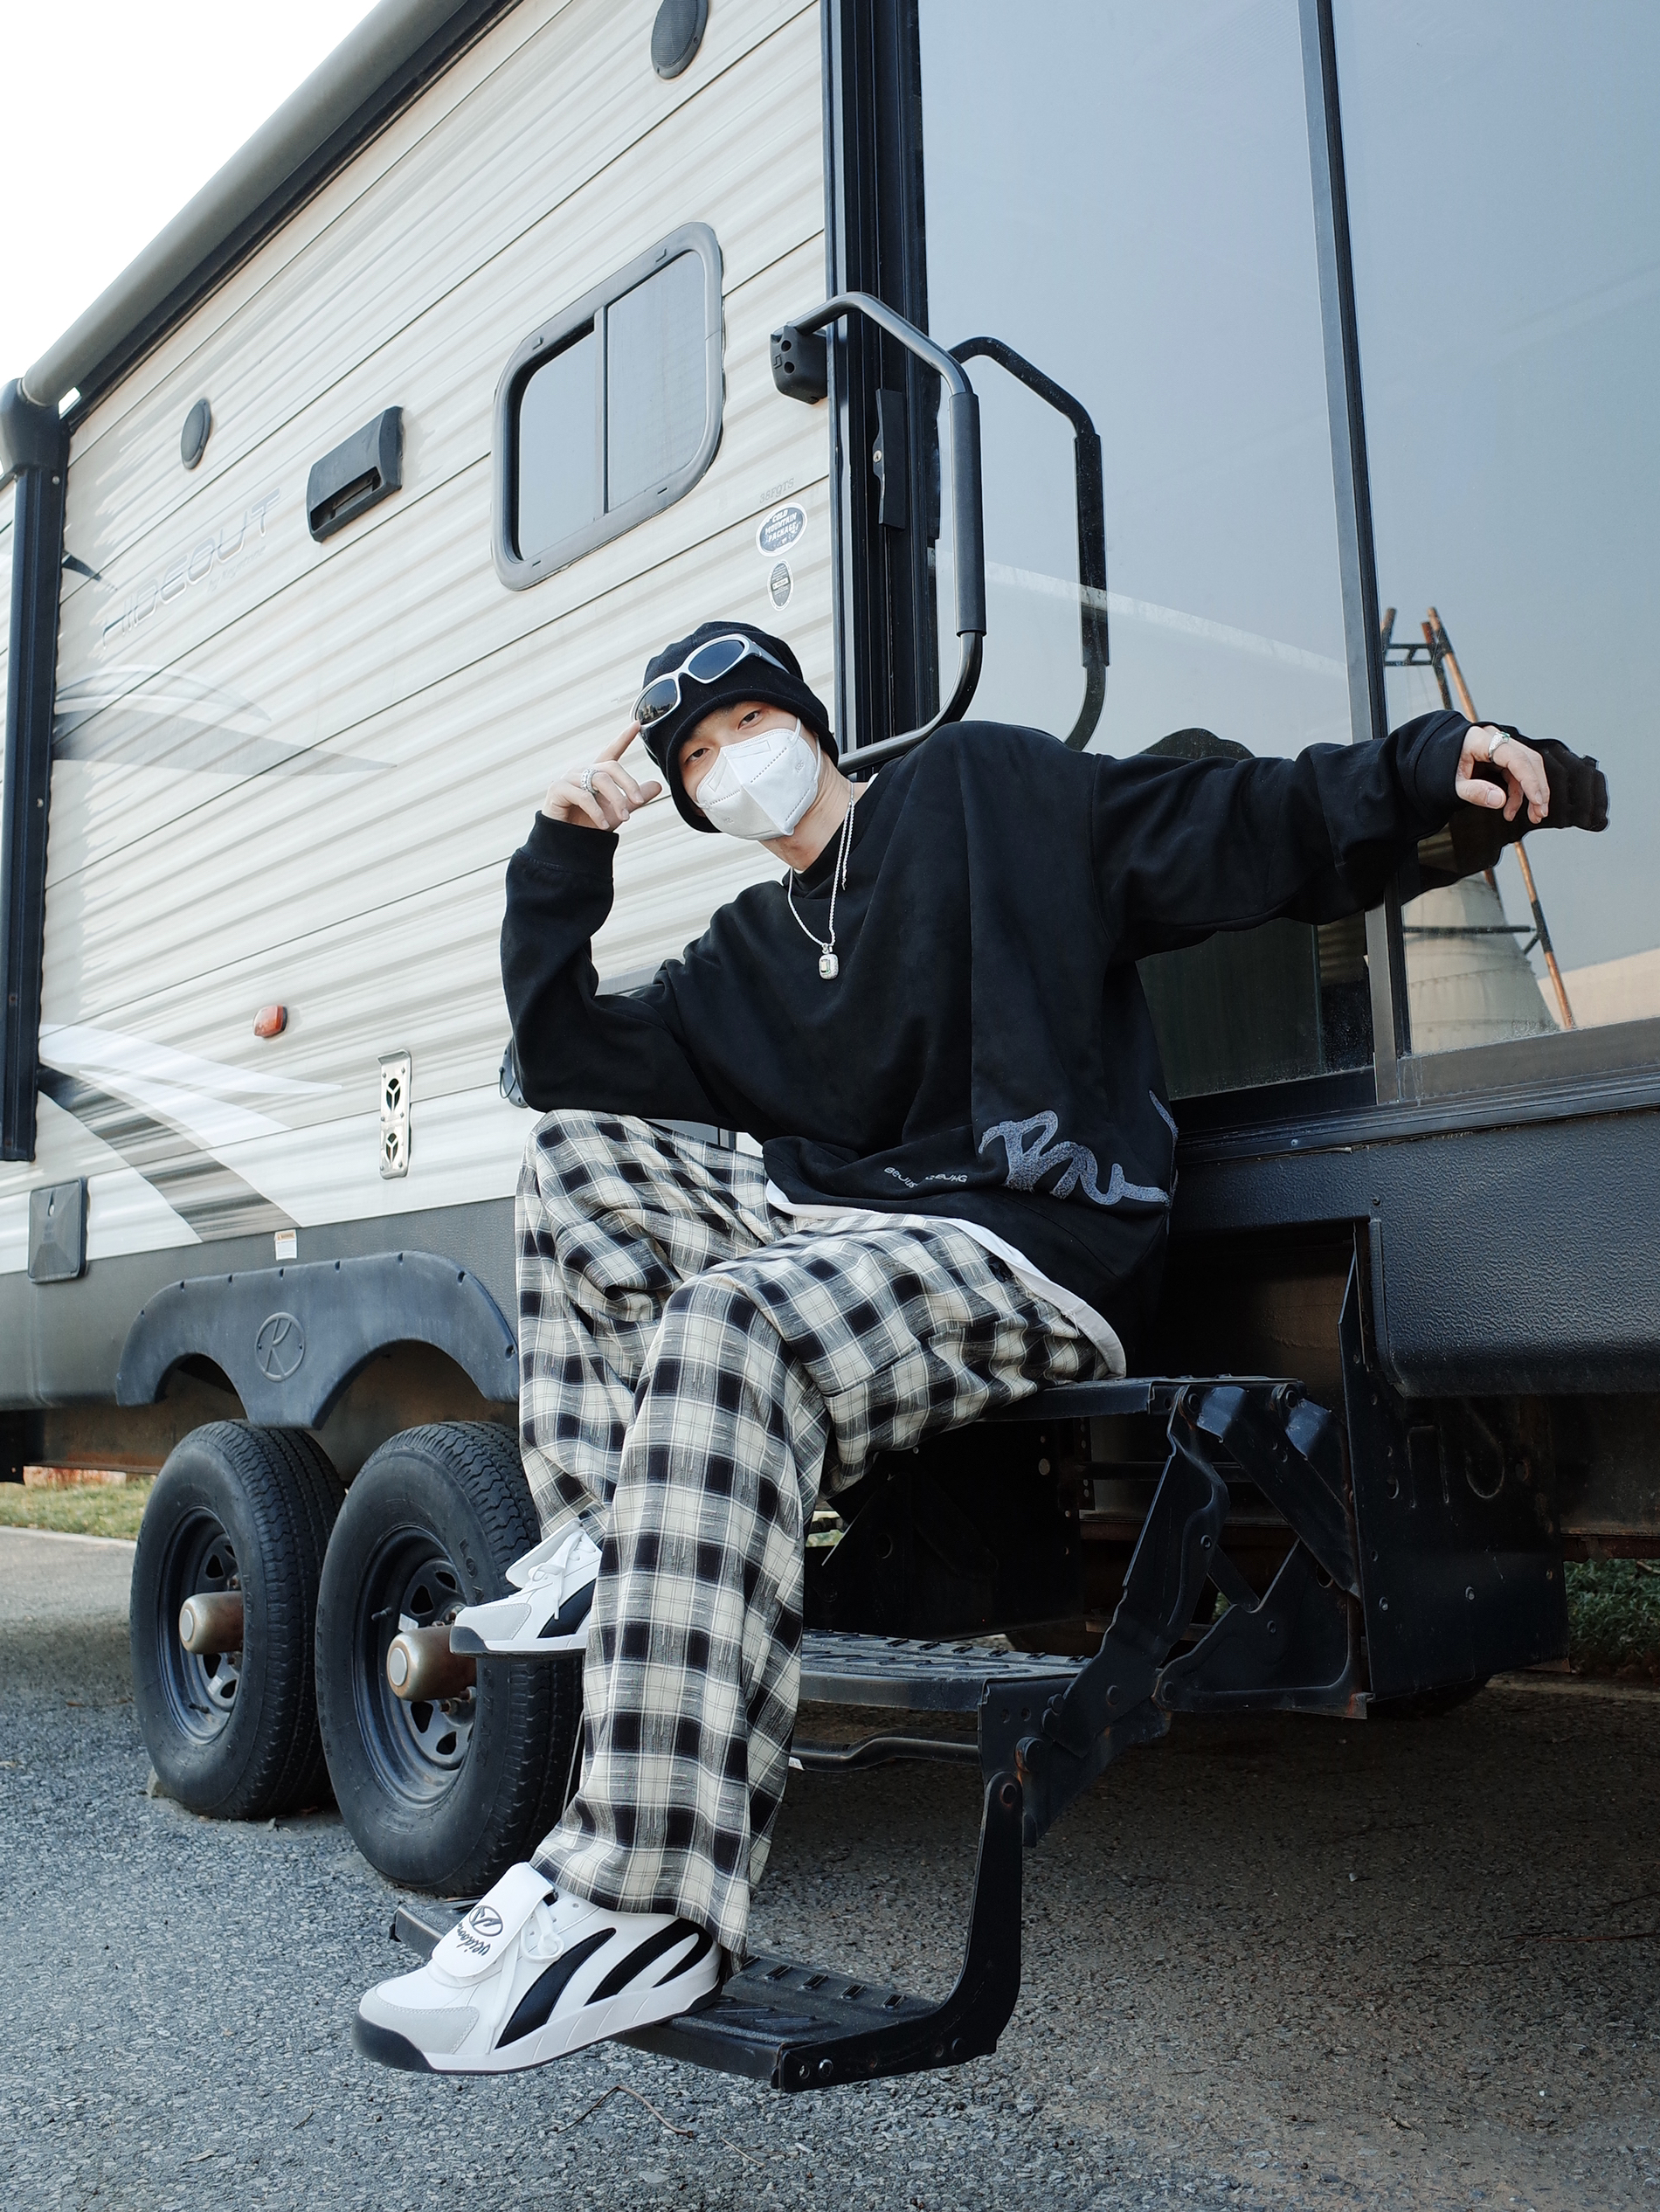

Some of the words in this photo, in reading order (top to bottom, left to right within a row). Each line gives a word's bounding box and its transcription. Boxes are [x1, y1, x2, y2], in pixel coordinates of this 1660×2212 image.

[764, 512, 797, 535] MOUNTAIN
[771, 509, 789, 523] COLD
[102, 487, 280, 649] HIDEOUT
